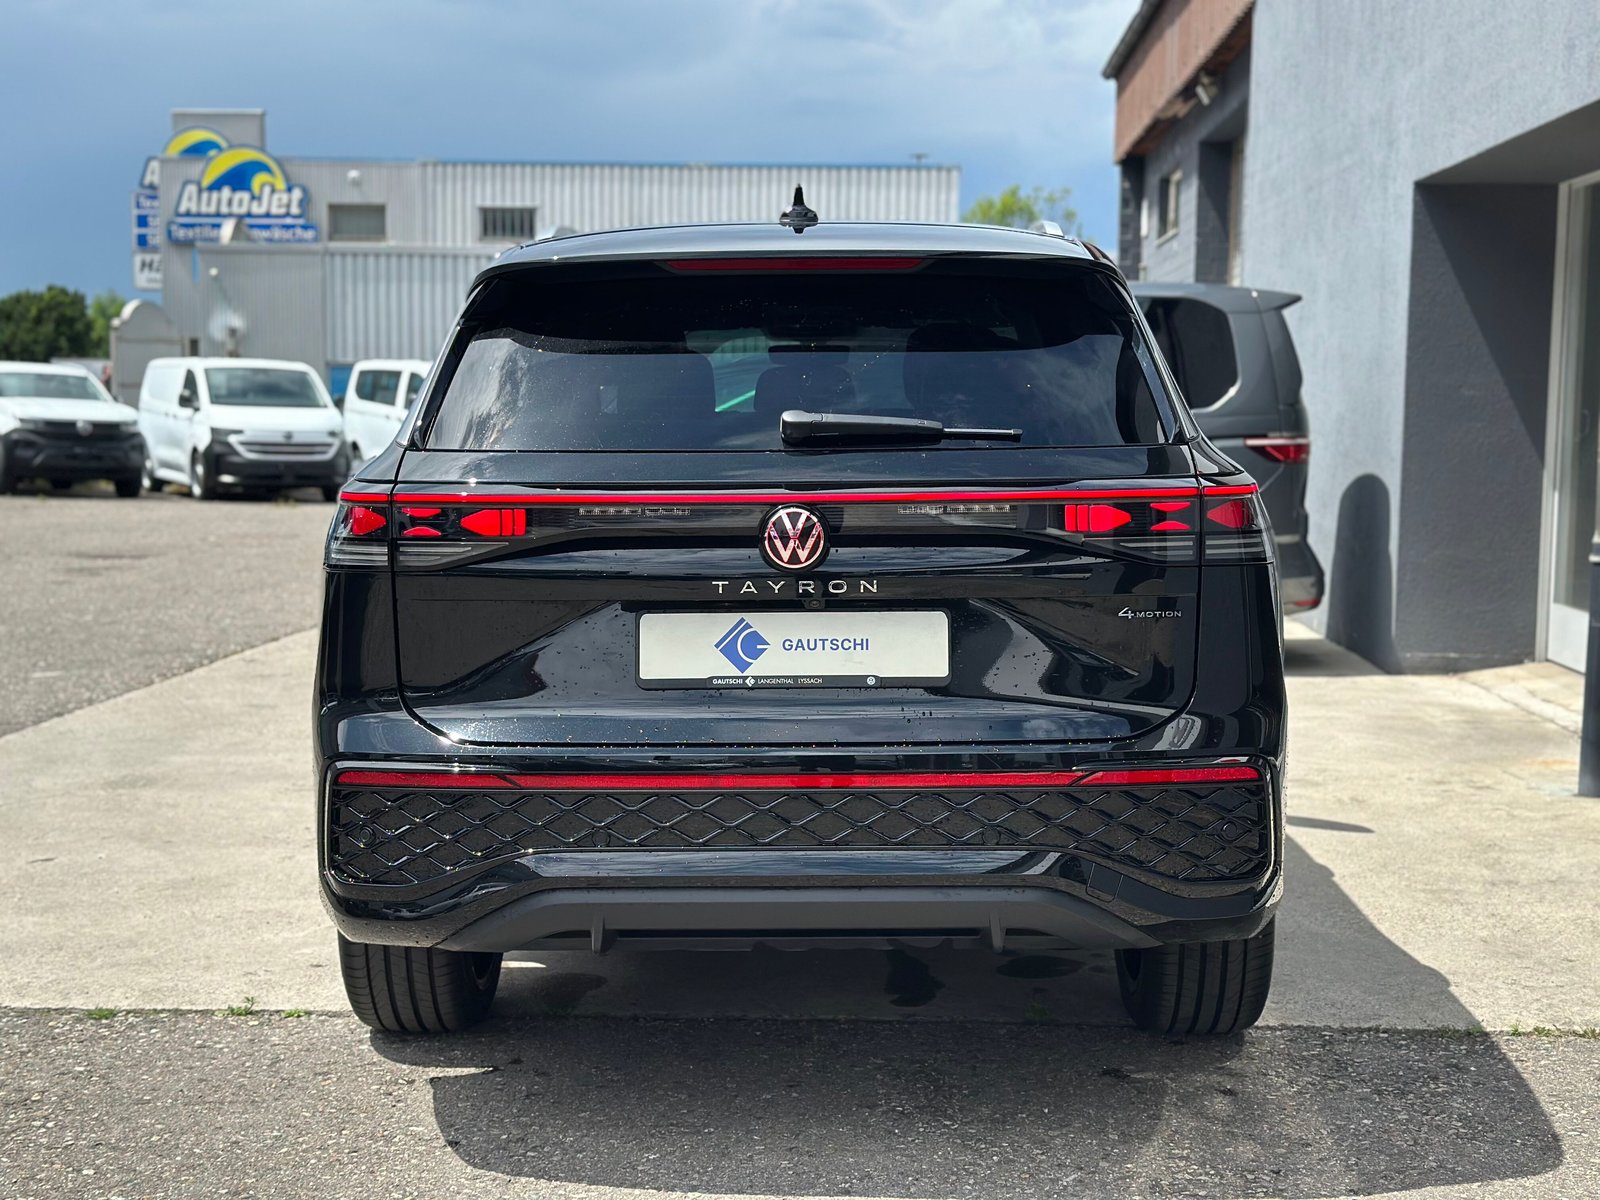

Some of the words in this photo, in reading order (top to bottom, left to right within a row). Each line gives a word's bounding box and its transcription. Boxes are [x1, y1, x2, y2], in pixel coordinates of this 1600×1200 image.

[177, 182, 304, 216] AutoJet
[712, 580, 879, 594] TAYRON
[1118, 606, 1182, 619] 4MOTION
[782, 637, 870, 651] GAUTSCHI
[757, 677, 794, 685] LANGENTHAL
[797, 676, 823, 684] LYSSACH
